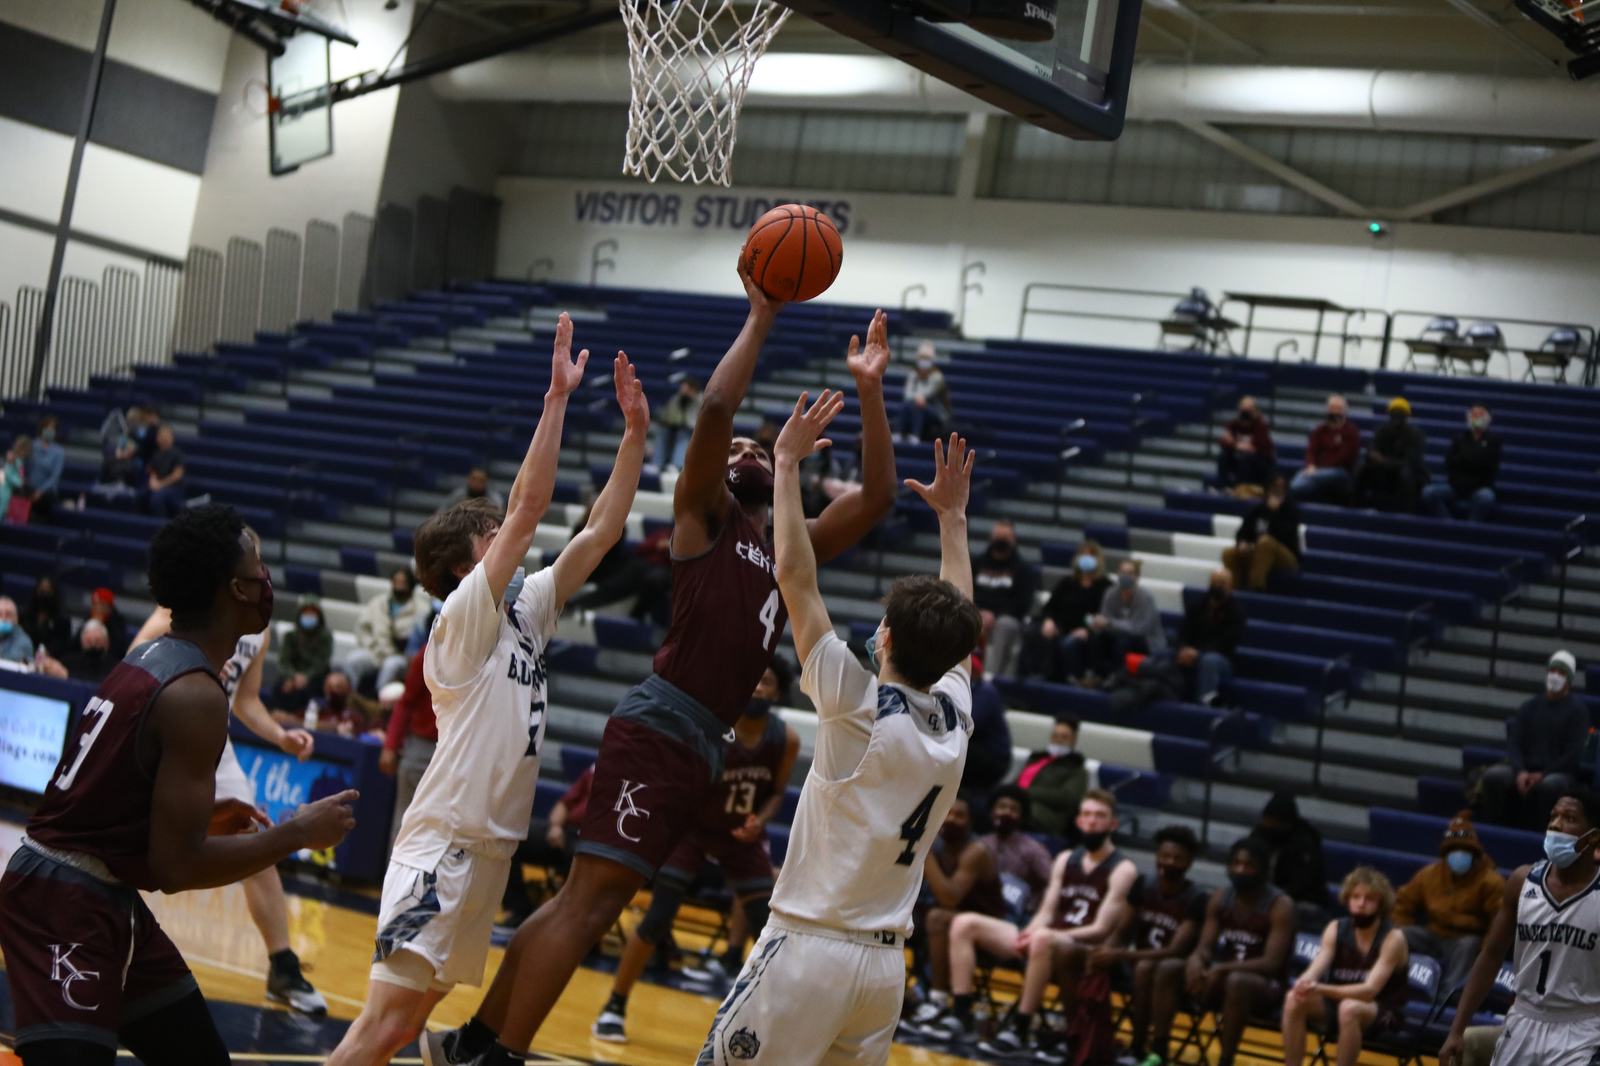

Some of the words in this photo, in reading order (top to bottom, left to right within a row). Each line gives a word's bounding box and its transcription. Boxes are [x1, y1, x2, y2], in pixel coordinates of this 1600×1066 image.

[575, 191, 681, 228] VISITOR
[759, 588, 780, 652] 4
[927, 713, 940, 731] GL
[611, 778, 651, 843] KC
[724, 781, 757, 815] 13
[895, 784, 943, 866] 4
[1548, 922, 1598, 951] DEVILS
[46, 942, 100, 1011] KC
[1536, 949, 1553, 995] 1
